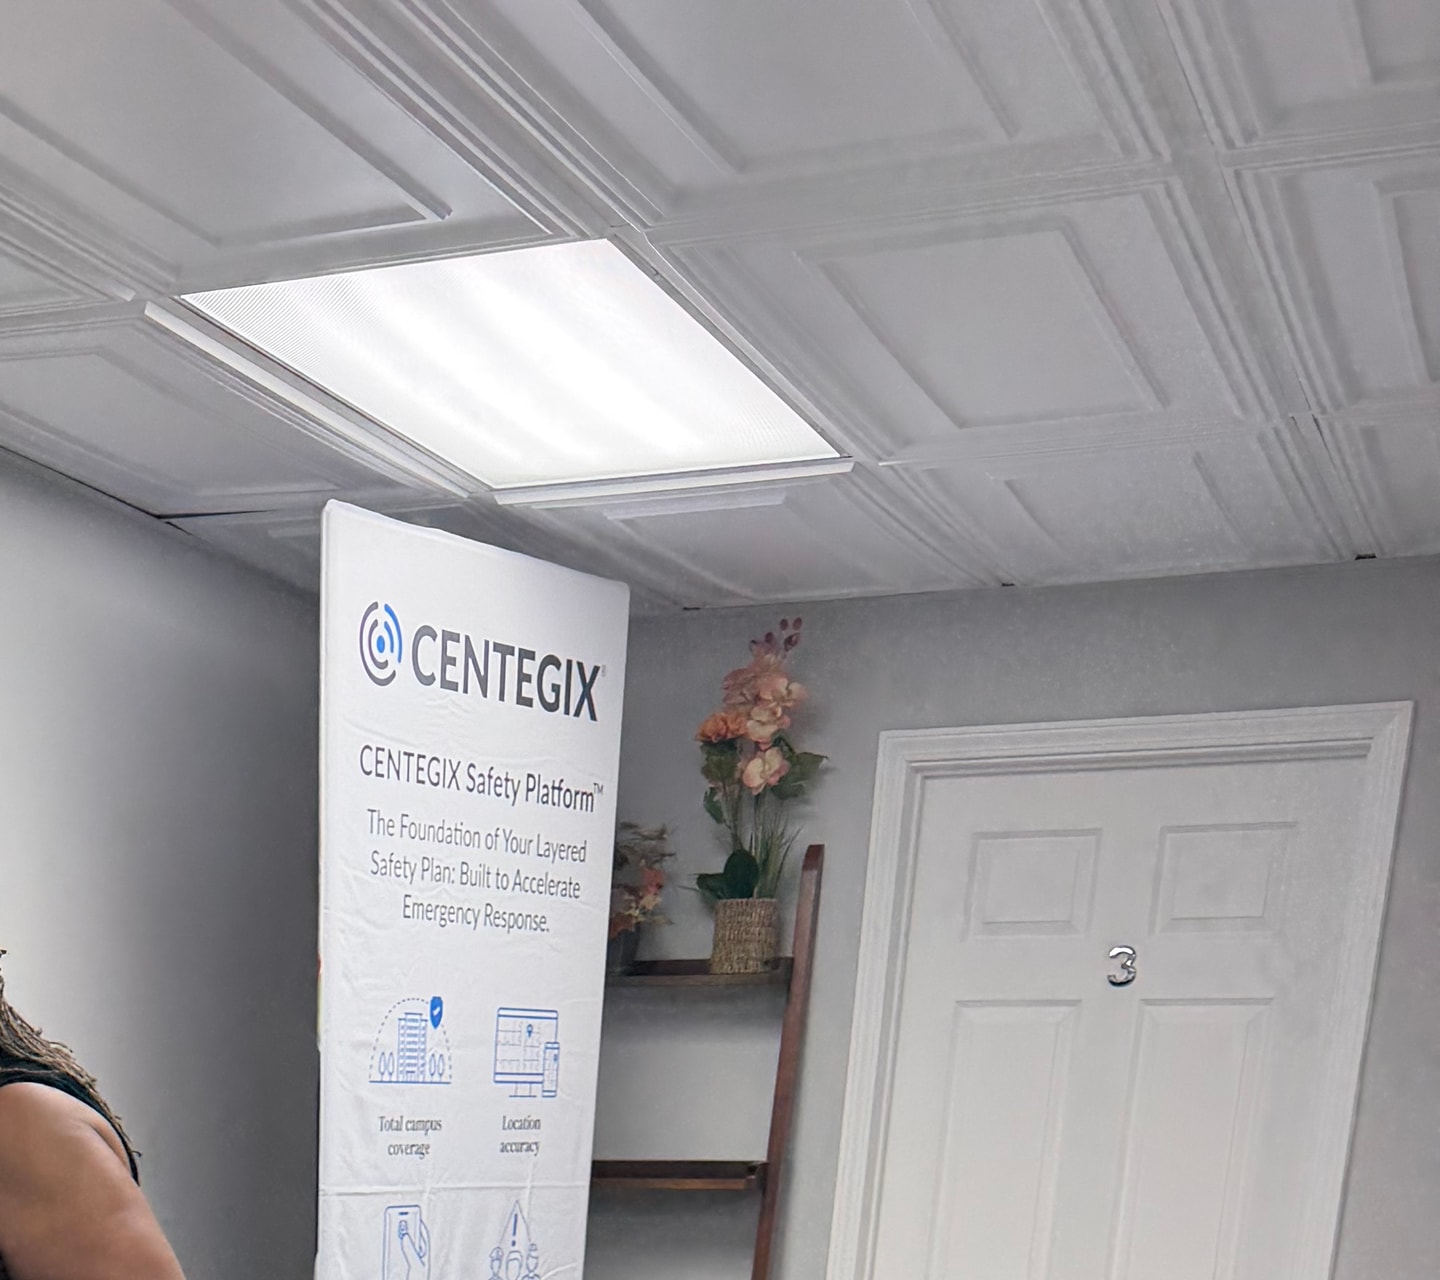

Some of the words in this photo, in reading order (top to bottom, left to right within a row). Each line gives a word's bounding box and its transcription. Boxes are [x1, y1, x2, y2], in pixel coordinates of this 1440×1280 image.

[412, 624, 600, 721] CENTEGIX
[360, 744, 460, 790] CENTEGIX
[466, 763, 521, 806] Safety
[367, 808, 395, 837] The
[400, 813, 480, 849] Foundation
[485, 827, 500, 851] of
[503, 828, 533, 856] Your
[536, 834, 587, 864] Layered
[370, 850, 417, 885] Safety
[421, 857, 455, 885] Plan:
[460, 861, 491, 889] Built
[496, 868, 509, 891] to
[512, 869, 580, 899] Accelerate
[402, 894, 480, 931] Emergency
[484, 903, 550, 934] Response.
[1107, 945, 1136, 987] 3
[378, 1115, 403, 1132] Total
[405, 1117, 442, 1136] campus
[502, 1115, 541, 1131] Location
[388, 1142, 431, 1159] coverage
[500, 1140, 540, 1157] accuracy
